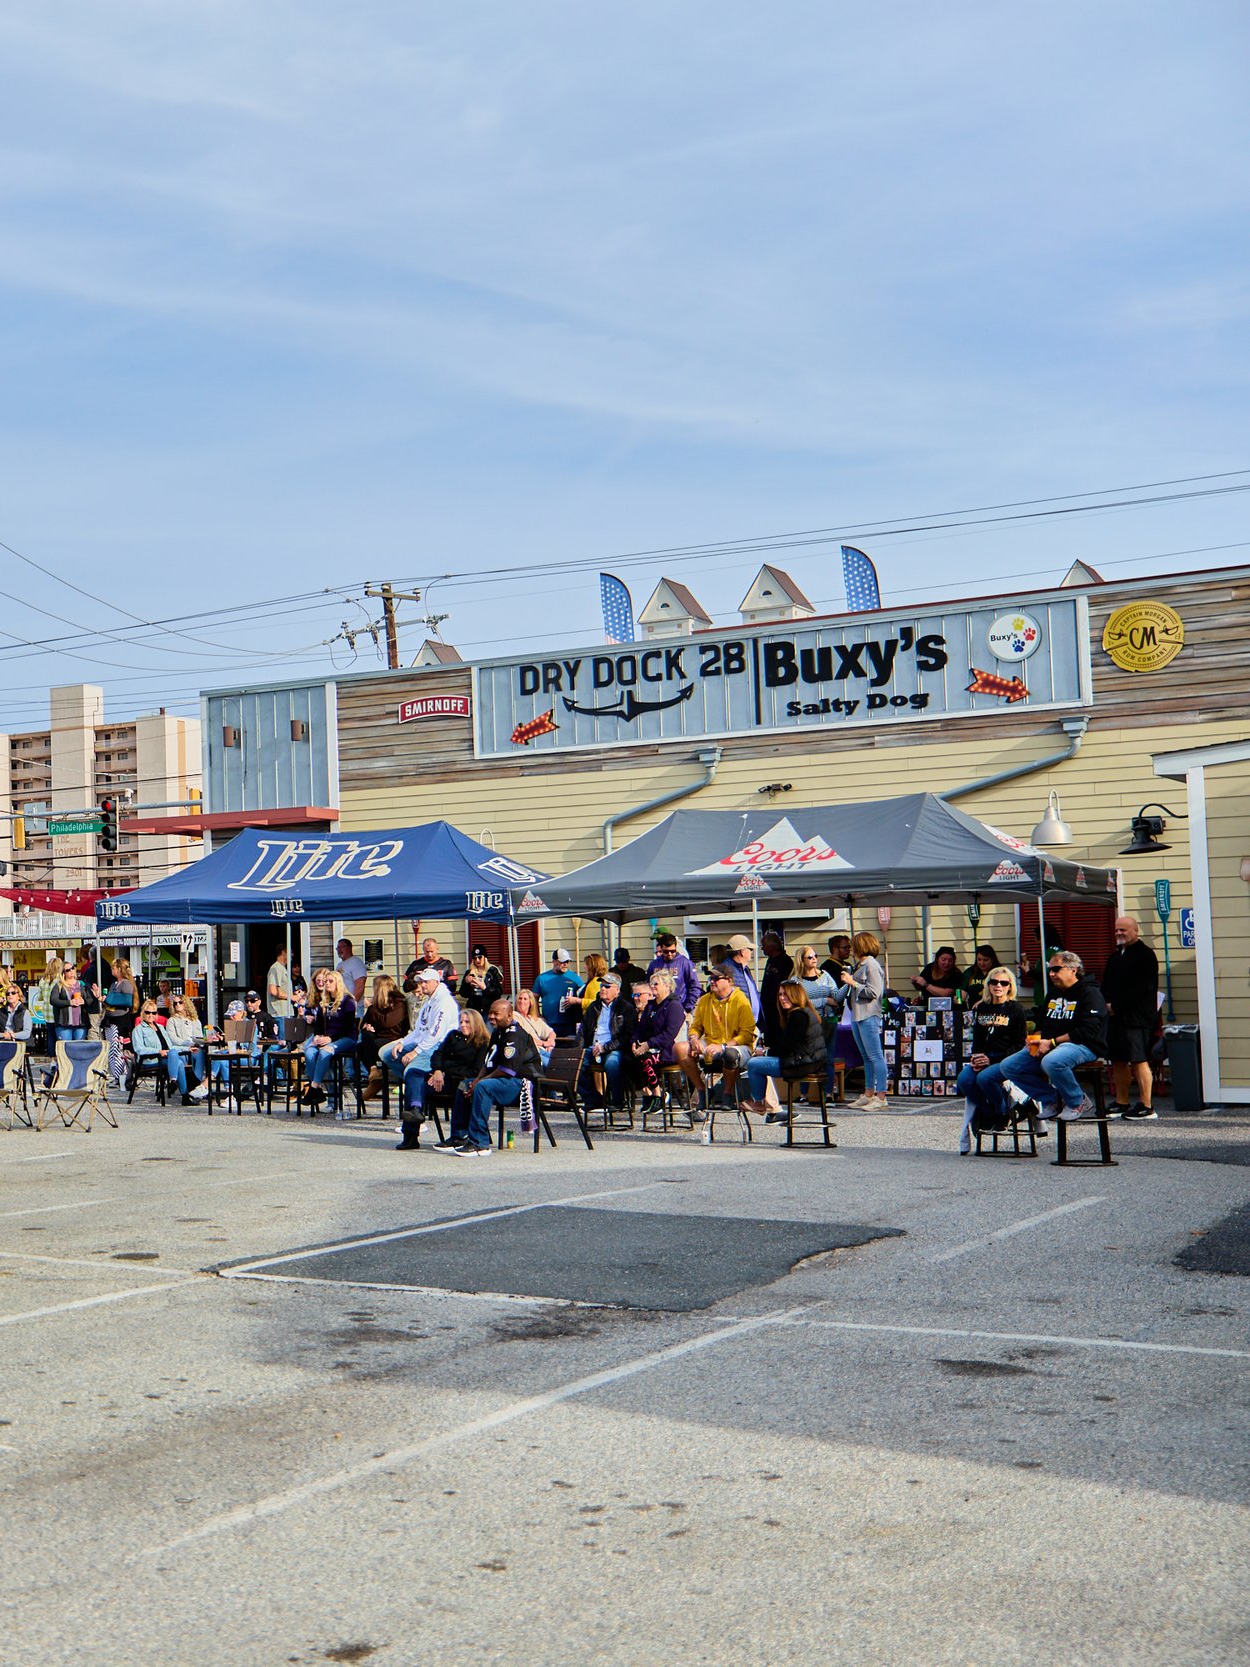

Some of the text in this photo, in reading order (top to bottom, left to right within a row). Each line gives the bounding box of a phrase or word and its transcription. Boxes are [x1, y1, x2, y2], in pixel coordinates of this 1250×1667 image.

[1120, 610, 1167, 627] CAPTAIN MORGAN
[990, 632, 1018, 642] Buxy's
[1129, 626, 1158, 650] CM
[763, 626, 948, 687] Buxy's
[1122, 647, 1168, 663] RUM COMPANY
[519, 641, 745, 696] DRY DOCK 28
[786, 692, 929, 717] Salty Dog
[50, 821, 94, 833] Philadelphia
[54, 846, 85, 857] TOWERS
[719, 841, 839, 866] Coors
[226, 839, 404, 893] Lite
[732, 861, 812, 873] LIGHT
[994, 864, 1026, 876] Coors
[739, 876, 766, 886] Coors
[100, 901, 131, 920] Lite
[465, 890, 503, 914] Lite
[16, 940, 62, 949] CANTINA
